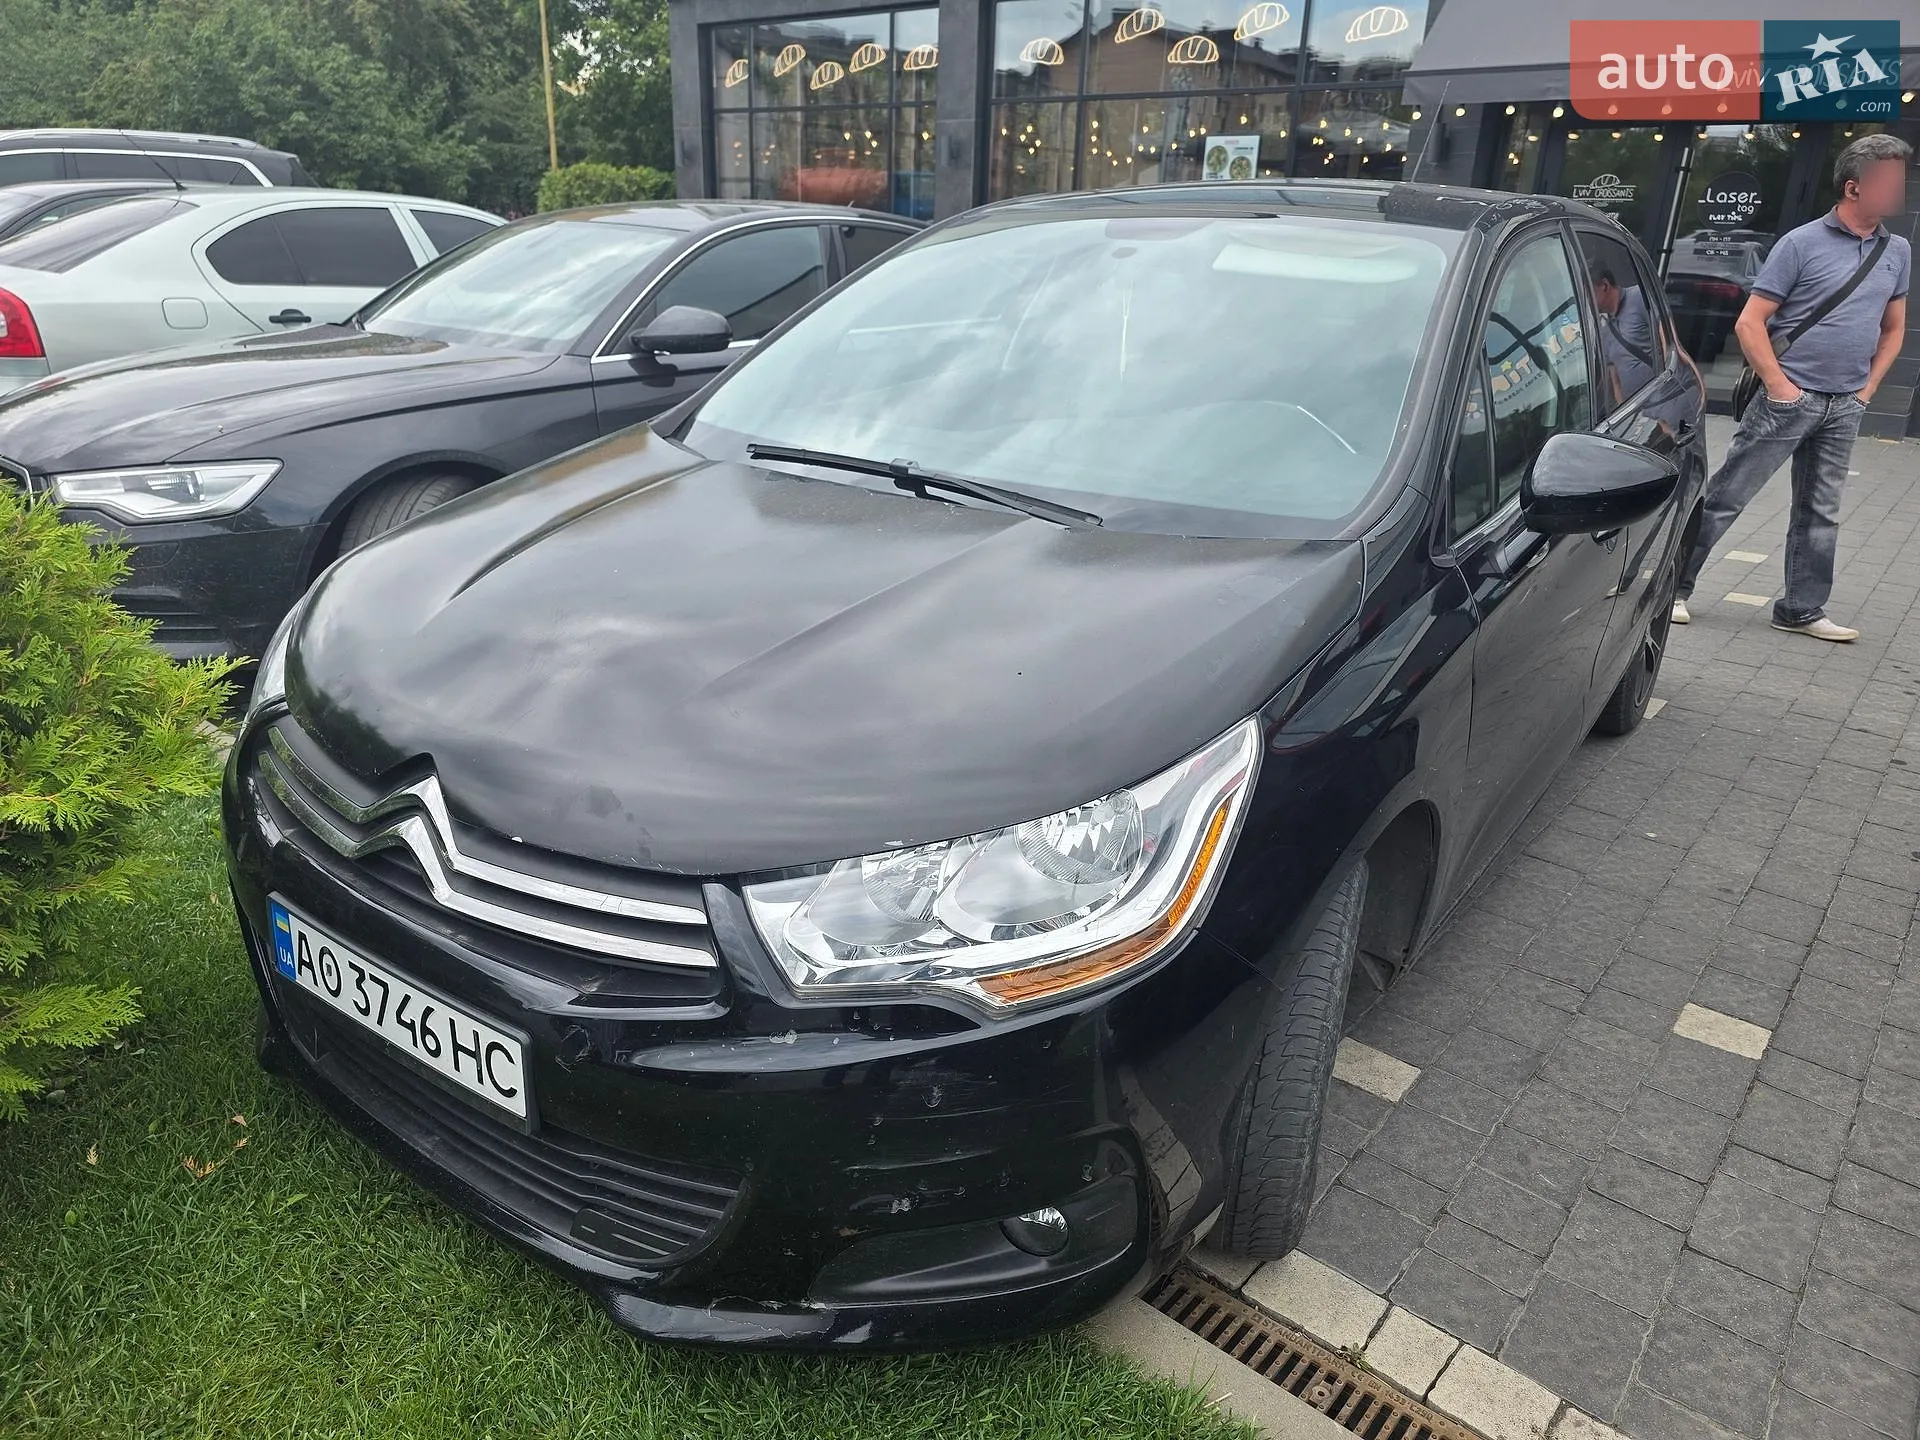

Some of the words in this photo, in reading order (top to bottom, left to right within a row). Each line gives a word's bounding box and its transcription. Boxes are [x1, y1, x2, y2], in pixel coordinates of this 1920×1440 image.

[1737, 203, 1755, 215] tag
[280, 946, 295, 969] UA
[296, 929, 343, 998] AO
[347, 959, 442, 1059] 3746
[448, 1016, 518, 1099] HC
